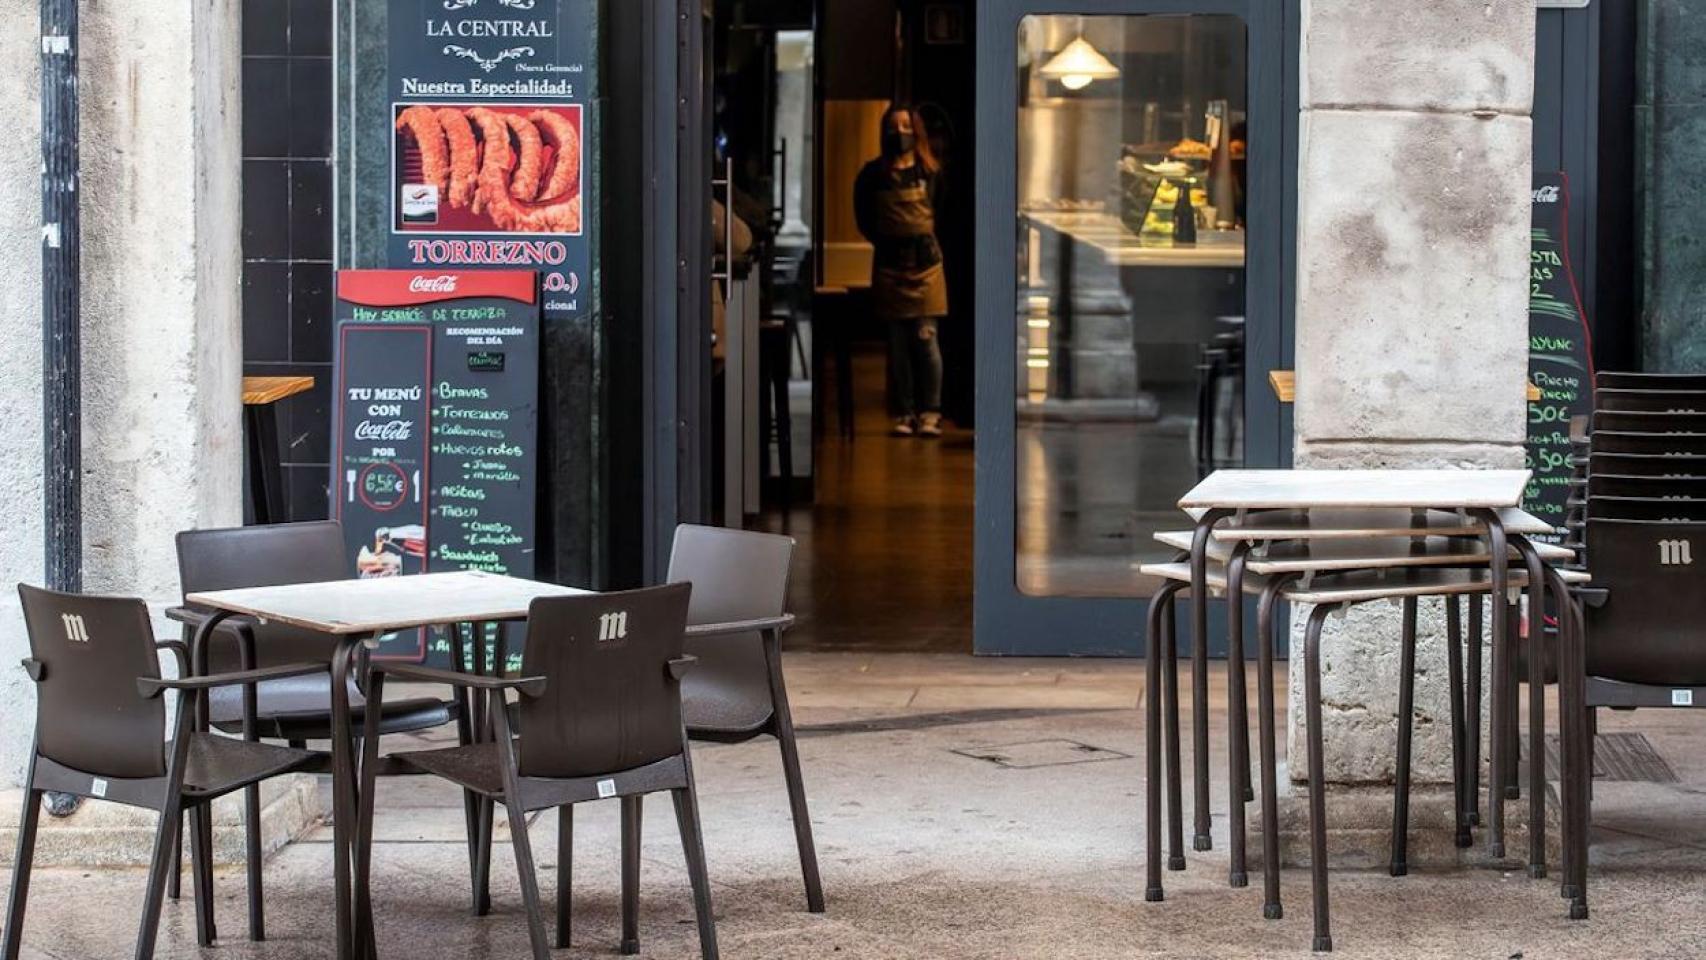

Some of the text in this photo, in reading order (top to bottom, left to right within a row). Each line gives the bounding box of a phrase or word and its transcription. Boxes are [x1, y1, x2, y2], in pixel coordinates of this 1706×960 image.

[427, 20, 553, 37] LA CENTRAL
[402, 78, 573, 97] Nuestra Especialidad:
[408, 240, 567, 265] TORREZNO
[446, 327, 524, 336] RECOMENDACIÓN
[467, 336, 503, 345] DEL DÍA
[349, 386, 421, 400] TU MENÚ
[368, 405, 402, 416] CON
[372, 447, 396, 457] POR
